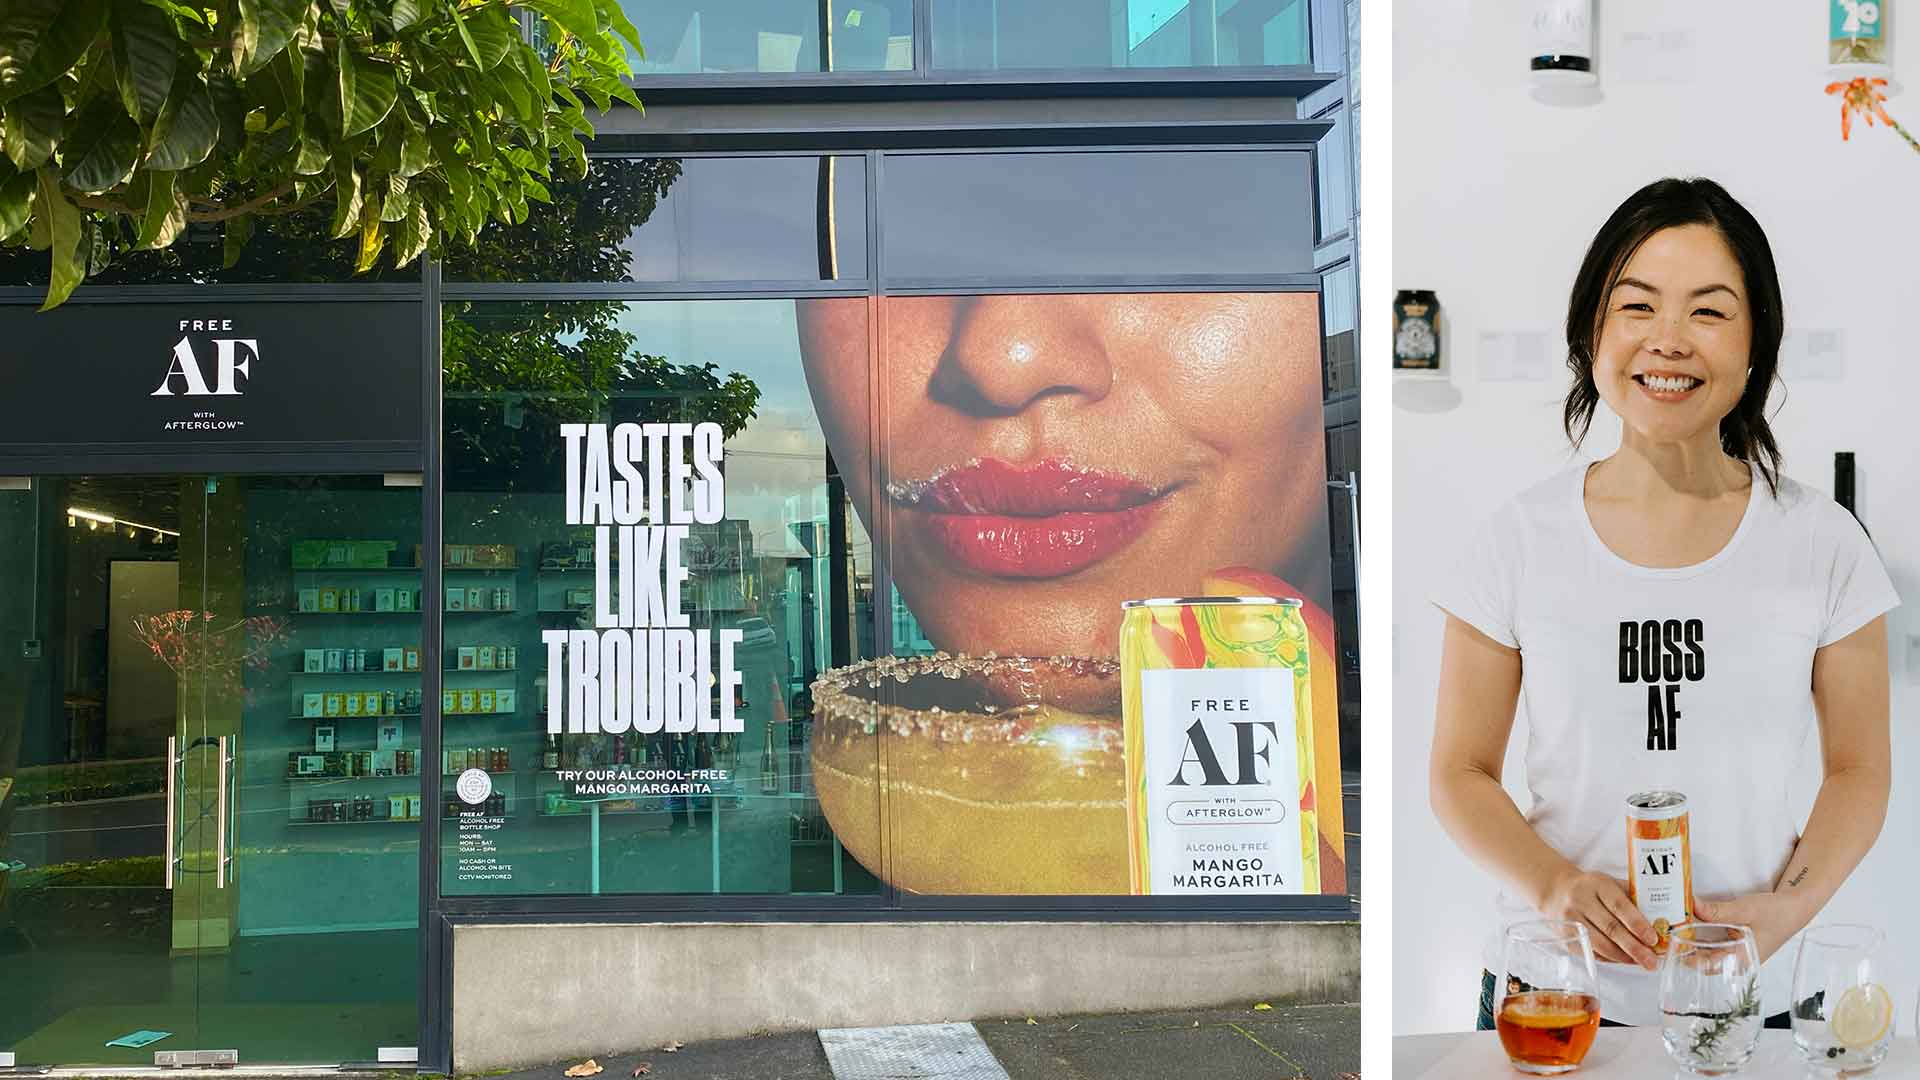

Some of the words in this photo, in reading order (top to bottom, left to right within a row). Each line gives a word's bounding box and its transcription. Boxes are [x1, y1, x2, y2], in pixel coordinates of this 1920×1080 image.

[180, 320, 232, 331] FREE
[151, 336, 259, 396] AF
[560, 423, 724, 525] TASTES
[595, 525, 690, 628] LIKE
[1619, 619, 1705, 683] BOSS
[542, 629, 745, 734] TROUBLE
[1191, 700, 1250, 711] FREE
[1647, 685, 1681, 750] AF
[1166, 718, 1279, 786] AF
[556, 770, 583, 781] TRY
[585, 770, 616, 781] OUR
[618, 770, 728, 780] ALCOHOL-FREE
[575, 783, 627, 794] MANGO
[630, 783, 712, 794] MARGARITA
[1186, 844, 1238, 852] ALCOHOL
[1241, 842, 1269, 851] FREE
[1193, 859, 1263, 871] MANGO
[1641, 854, 1676, 875] AF
[1173, 874, 1284, 888] MARGARITA
